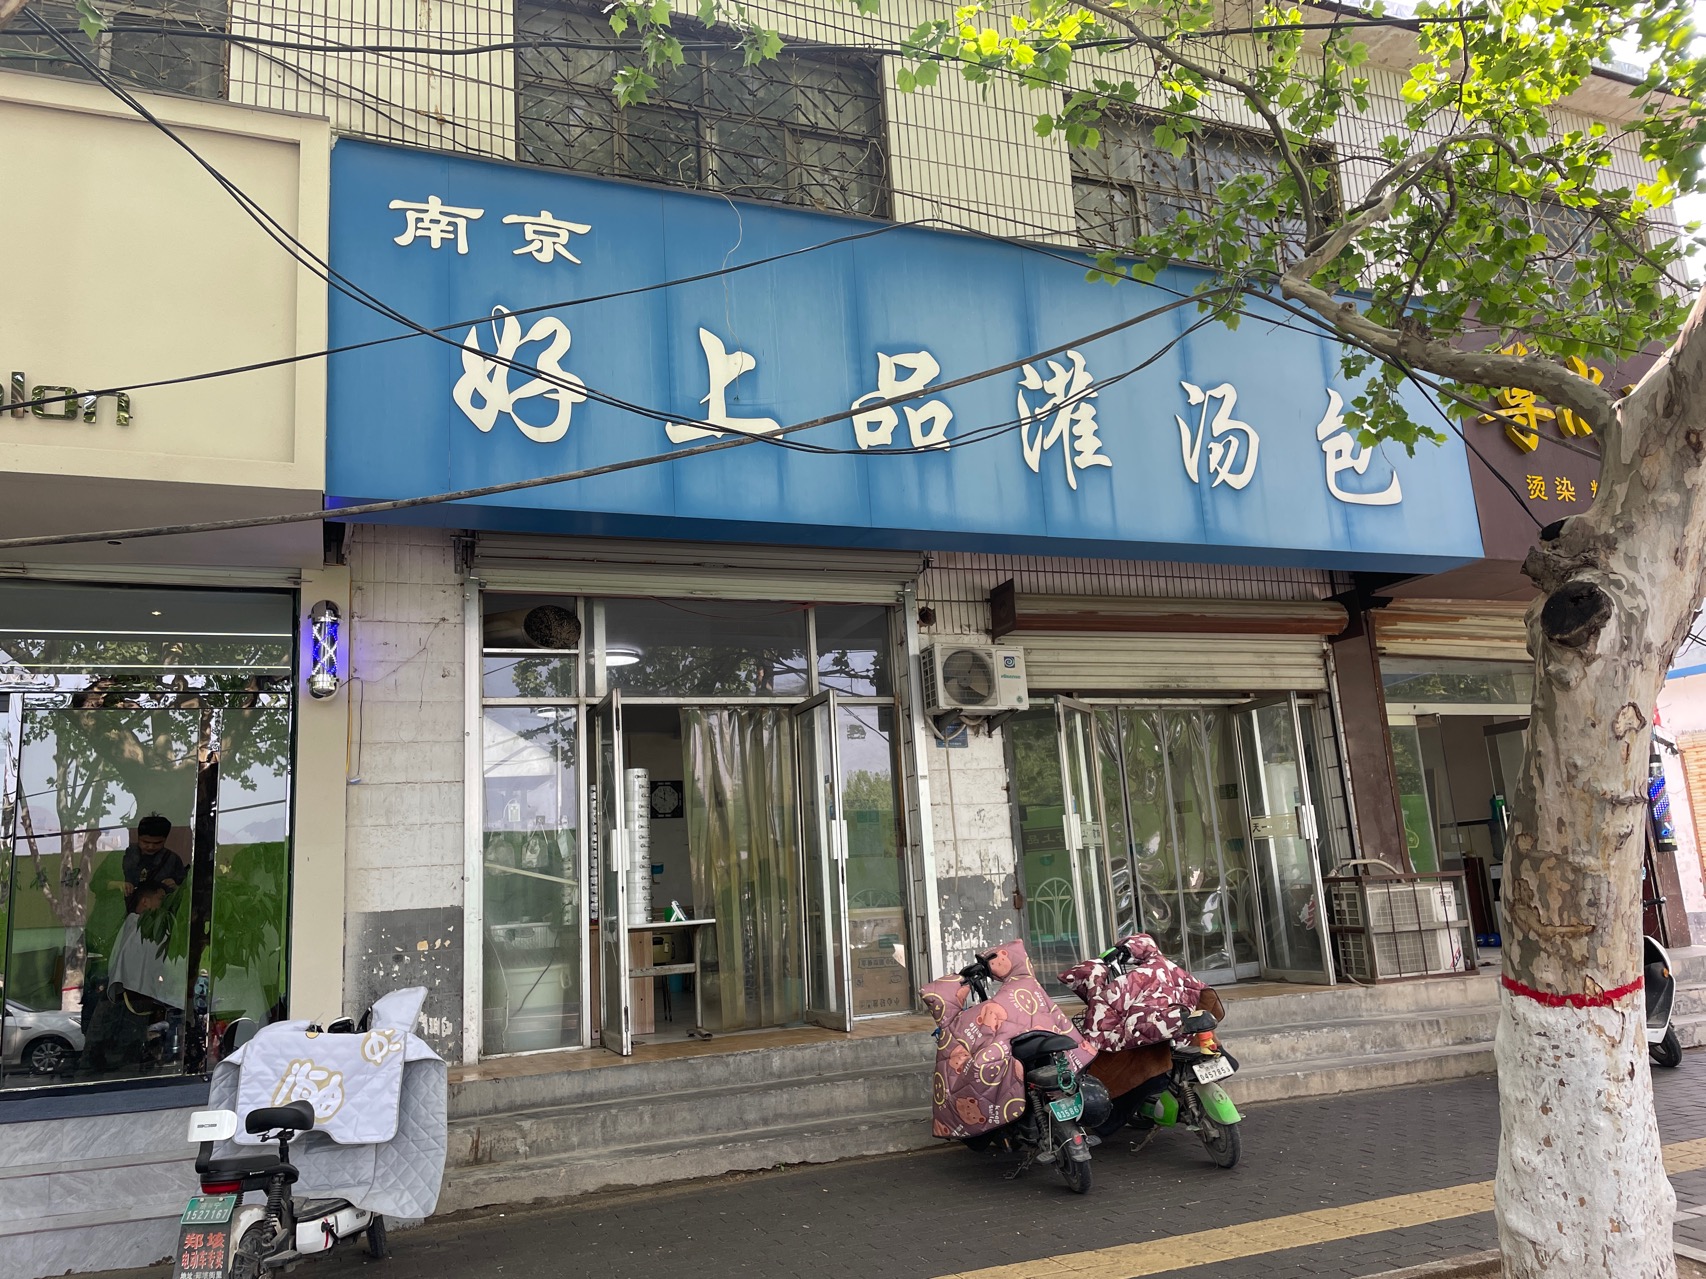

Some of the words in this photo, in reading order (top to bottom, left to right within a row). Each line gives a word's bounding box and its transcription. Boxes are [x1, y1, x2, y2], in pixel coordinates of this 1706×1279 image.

[388, 194, 592, 266] 南京
[0, 370, 131, 426] lon
[452, 304, 1403, 506] 好上品灌汤包
[1525, 473, 1577, 502] 烫染
[186, 1209, 228, 1221] 1527167
[183, 1232, 226, 1250] 郑垓
[181, 1249, 225, 1270] 电动车专卖
